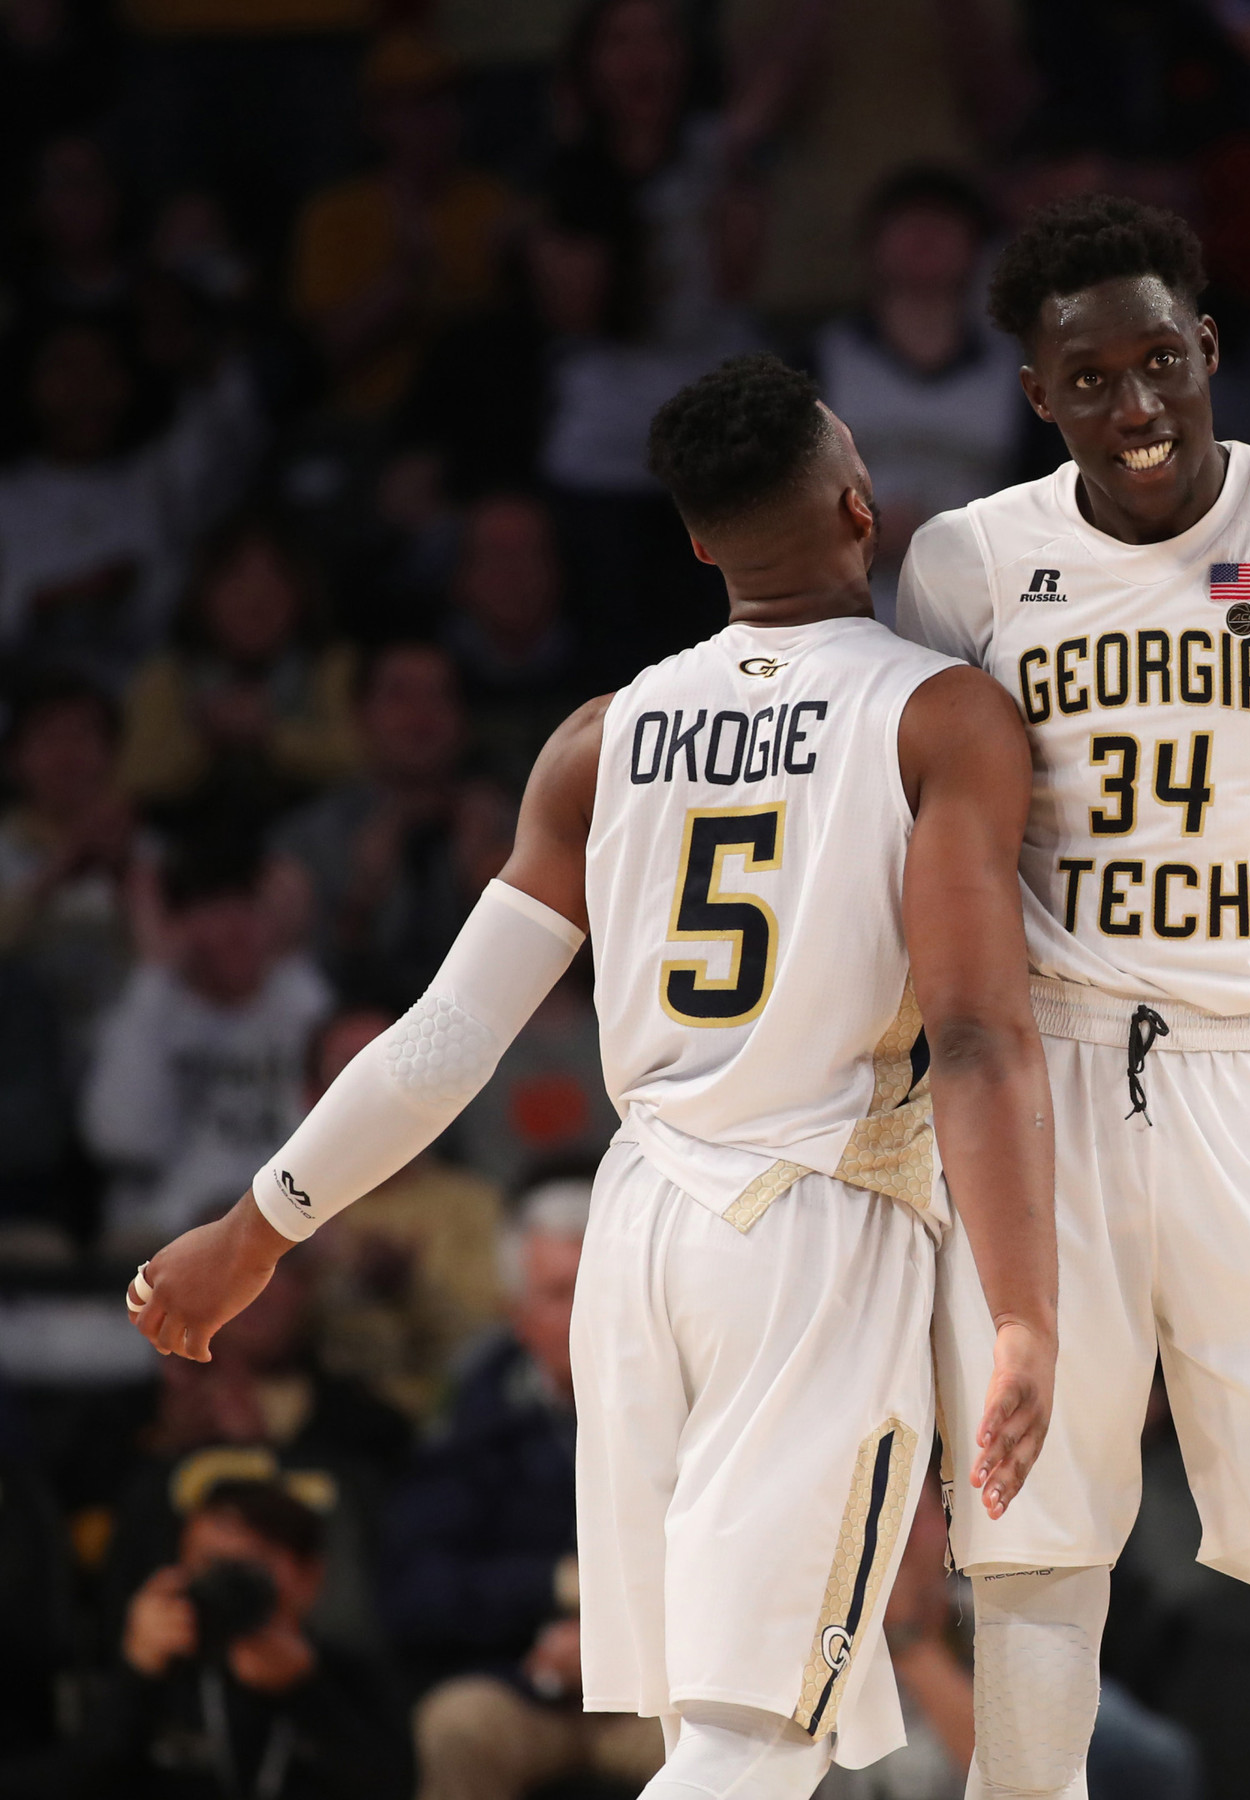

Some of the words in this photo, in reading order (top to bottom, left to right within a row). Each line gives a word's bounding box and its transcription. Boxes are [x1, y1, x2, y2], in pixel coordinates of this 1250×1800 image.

[1019, 593, 1068, 602] RUSSELL
[630, 701, 828, 785] OKOGIE
[1088, 730, 1215, 838] 34
[659, 801, 787, 1029] 5
